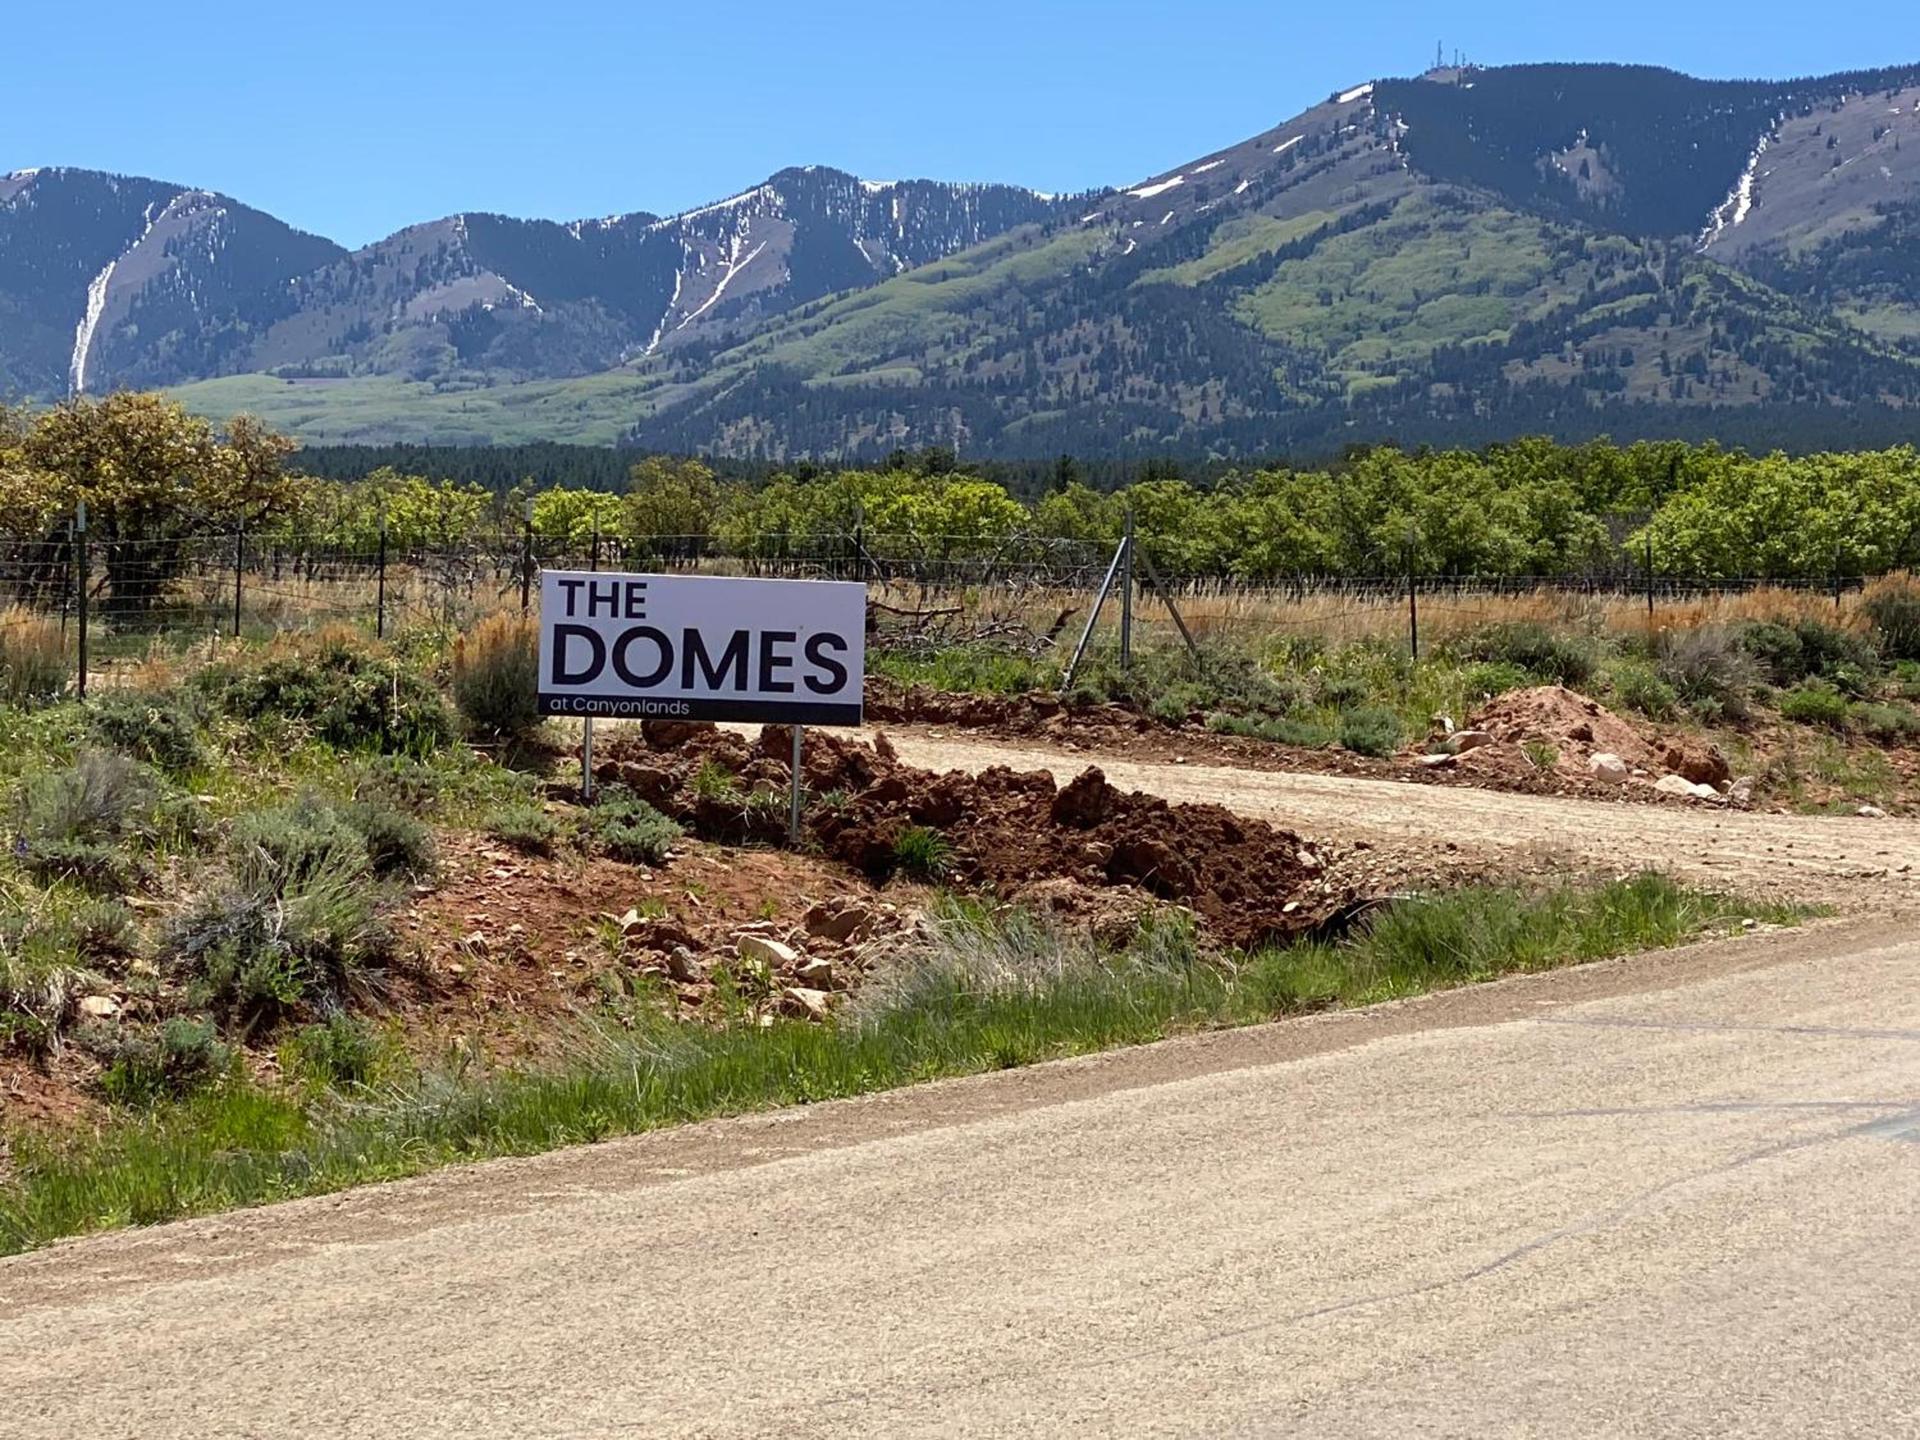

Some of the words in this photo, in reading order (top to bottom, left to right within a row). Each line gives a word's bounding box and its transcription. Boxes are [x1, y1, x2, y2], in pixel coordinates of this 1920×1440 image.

[558, 580, 647, 619] THE
[552, 624, 848, 695] DOMES
[550, 698, 568, 711] at
[573, 697, 690, 716] Canyonlands
